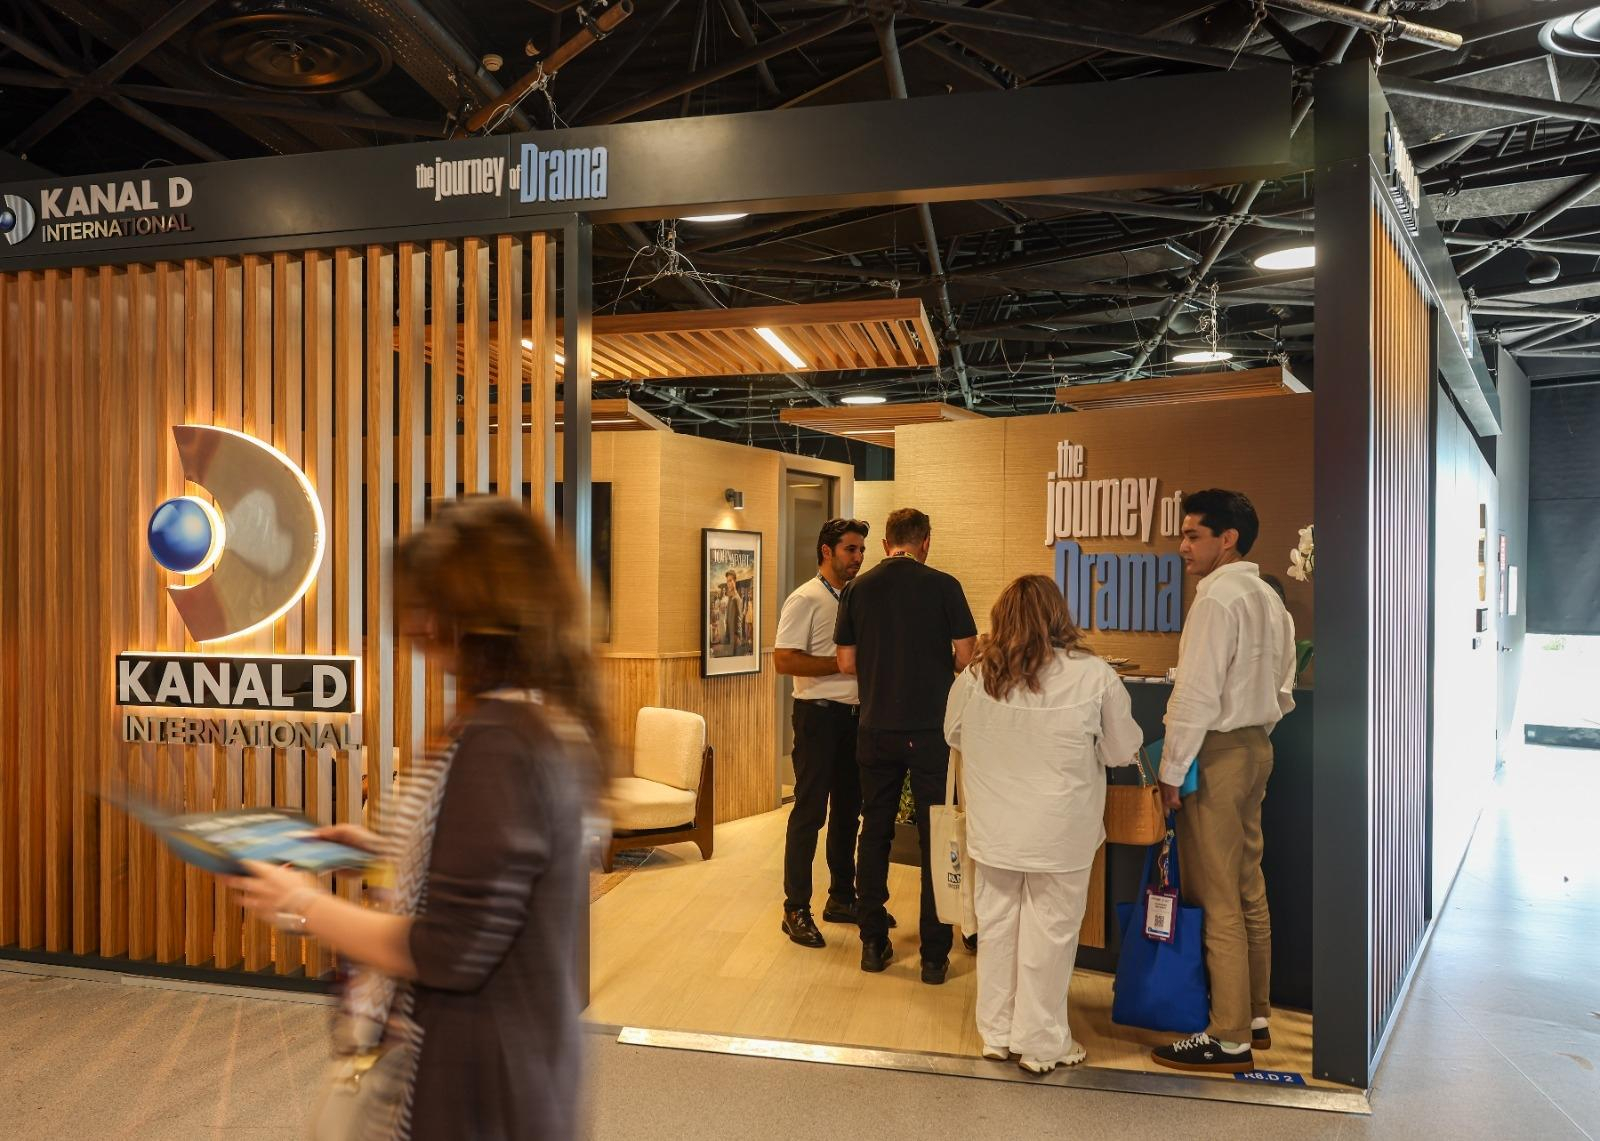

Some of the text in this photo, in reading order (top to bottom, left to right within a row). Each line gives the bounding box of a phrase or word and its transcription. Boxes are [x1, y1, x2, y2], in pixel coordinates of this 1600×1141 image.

[415, 143, 608, 203] the journey of Drama
[40, 176, 193, 220] KANAL D
[42, 213, 194, 243] INTERNATIONAL
[1057, 439, 1084, 479] the
[1044, 471, 1182, 546] journey of
[1055, 540, 1182, 633] Drama
[119, 660, 348, 709] KANAL D
[122, 714, 361, 750] INTERNATIONAL
